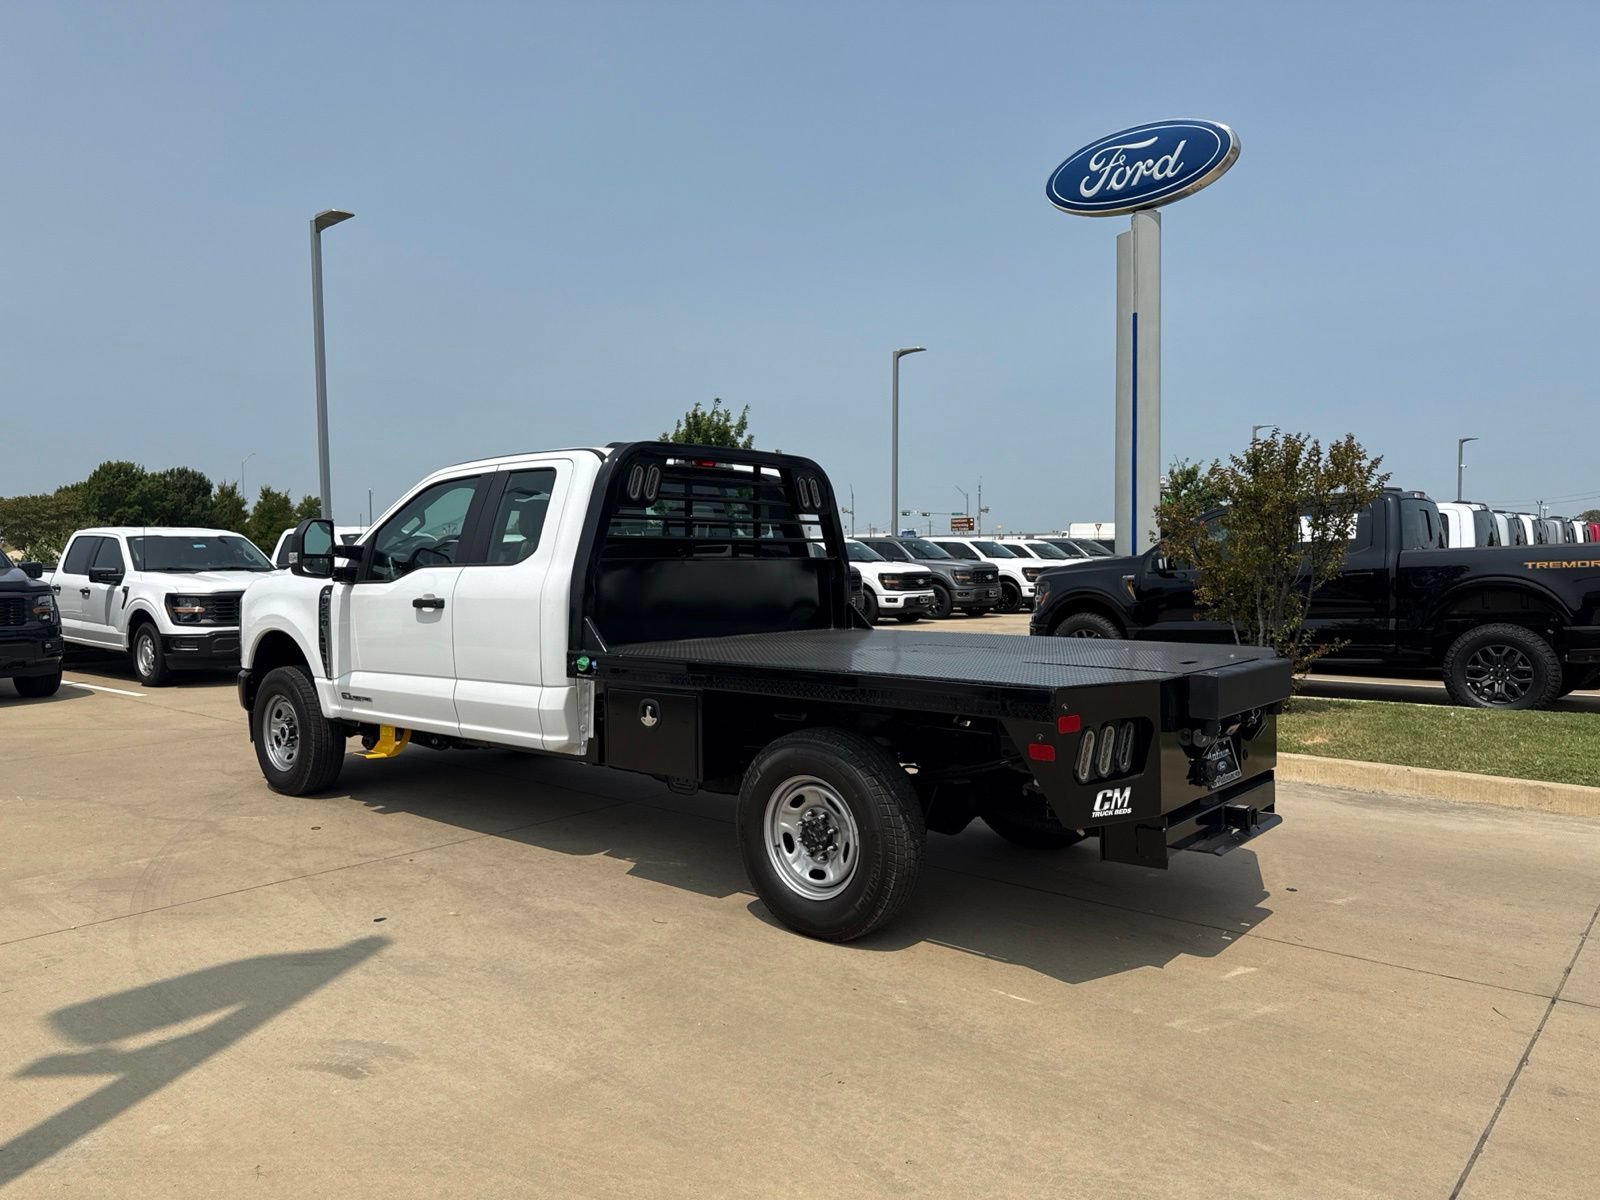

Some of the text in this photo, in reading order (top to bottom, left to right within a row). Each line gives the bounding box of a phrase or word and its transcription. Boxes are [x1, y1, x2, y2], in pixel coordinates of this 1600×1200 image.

[1080, 136, 1187, 198] Ford
[1524, 560, 1600, 569] TREMOR
[1094, 787, 1132, 811] CM
[1092, 807, 1132, 818] TRUCK BEDS
